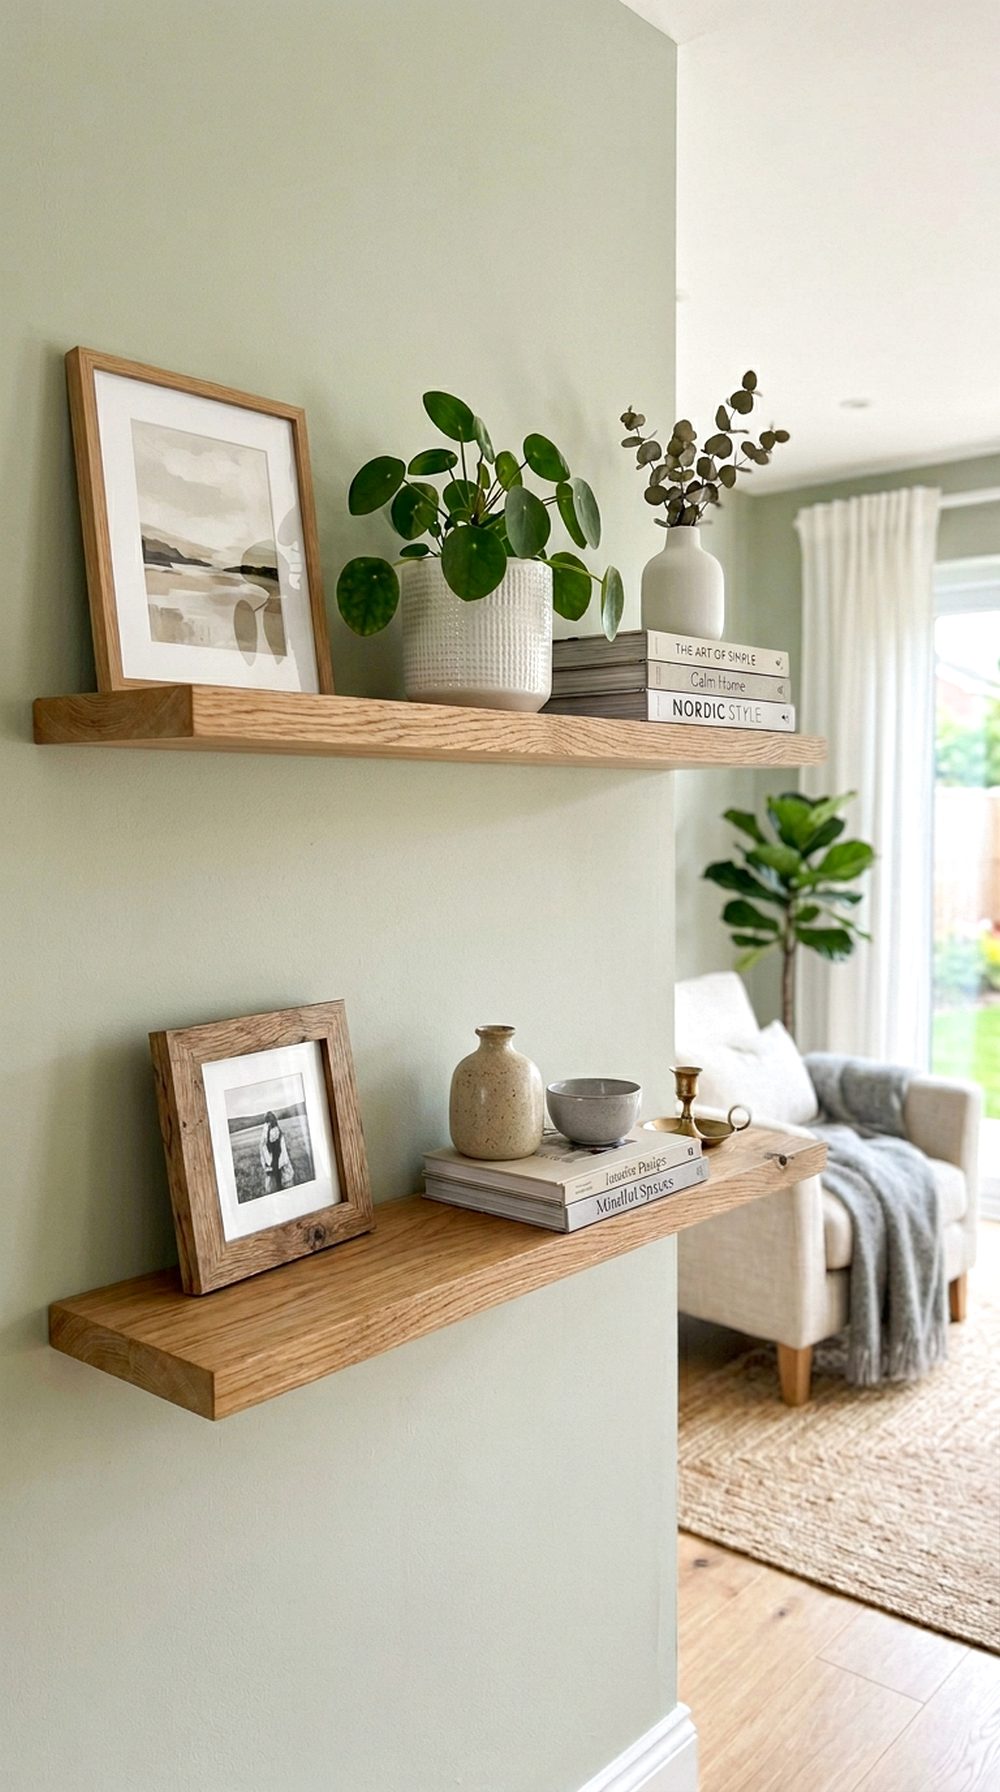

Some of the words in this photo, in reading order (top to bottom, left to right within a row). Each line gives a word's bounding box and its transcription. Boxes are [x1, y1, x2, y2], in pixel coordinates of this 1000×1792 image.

[675, 643, 692, 656] THE
[695, 646, 713, 658] ART
[714, 649, 726, 660] OF
[690, 671, 716, 689] Calm
[718, 675, 746, 692] Home
[672, 698, 726, 720] NORDIC
[728, 704, 762, 723] STYLE
